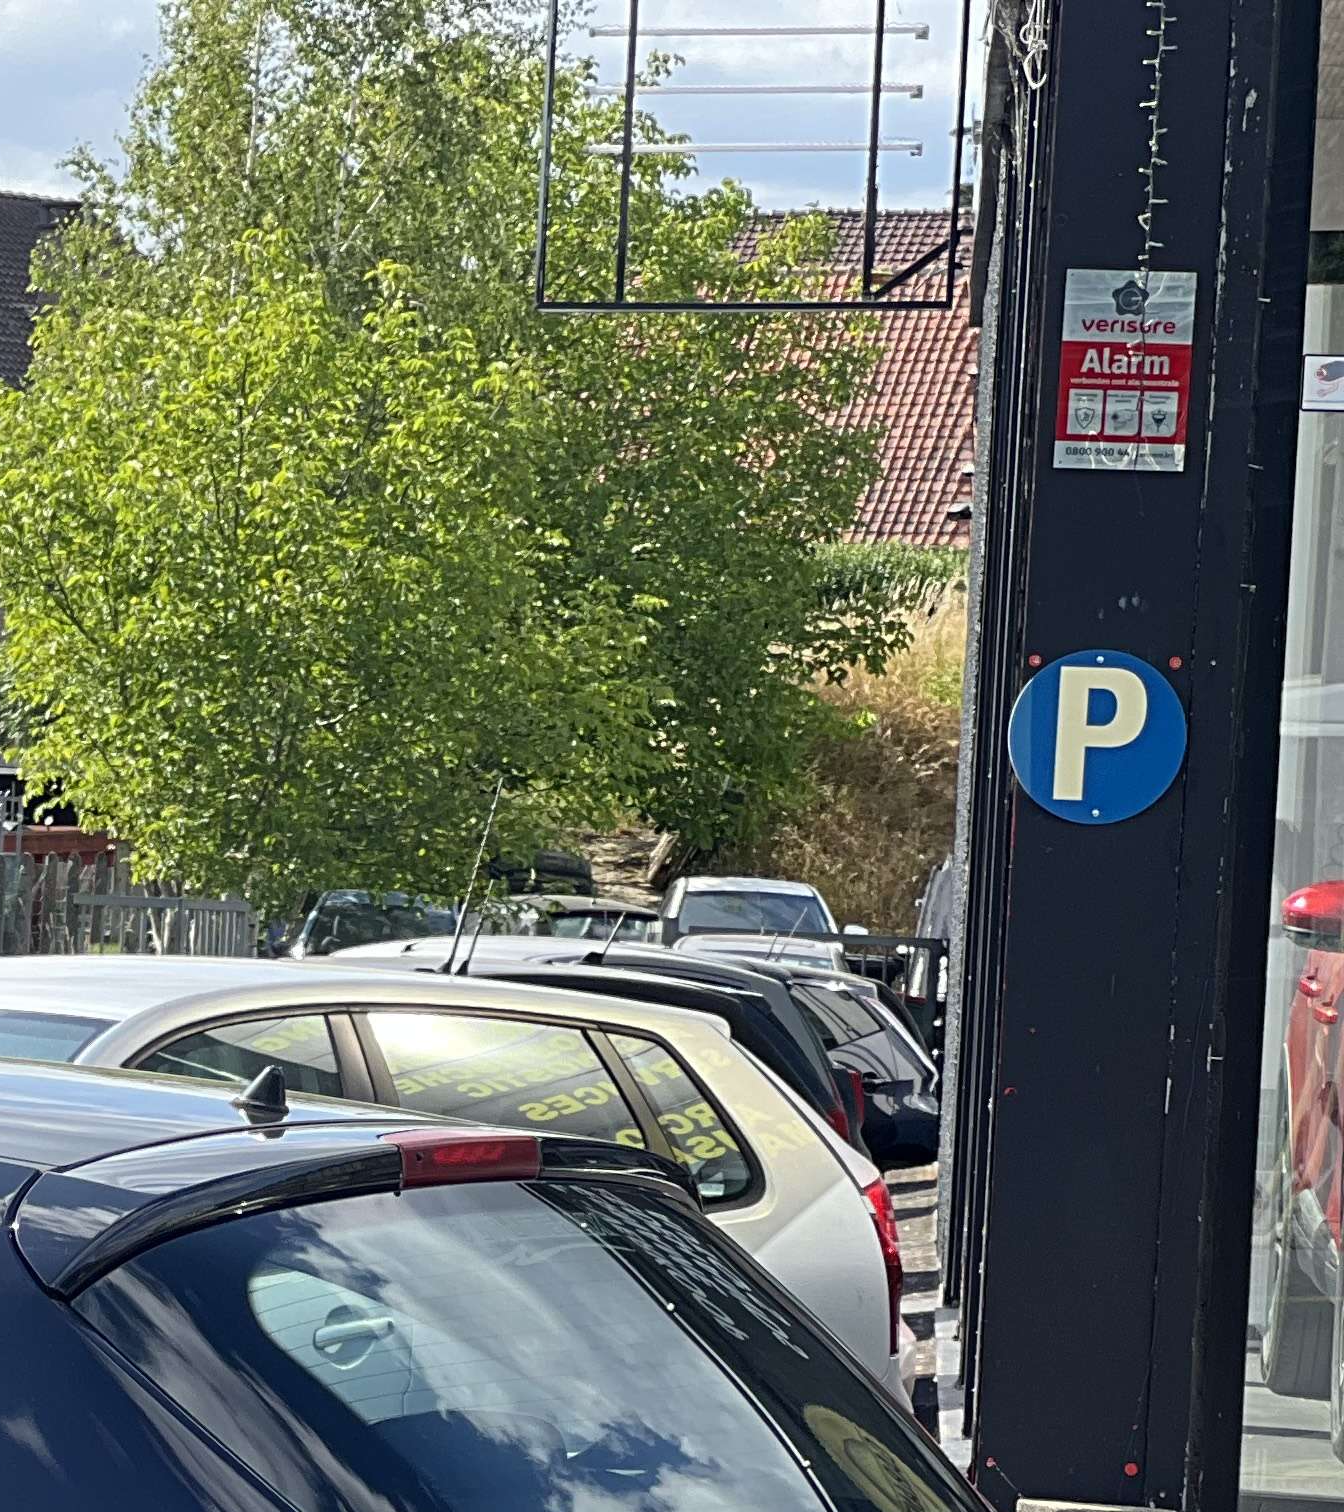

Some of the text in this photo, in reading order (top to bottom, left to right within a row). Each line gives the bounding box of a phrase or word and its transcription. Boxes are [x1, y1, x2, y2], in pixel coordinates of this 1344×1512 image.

[1081, 318, 1176, 334] verisure
[1080, 347, 1170, 375] Alarm
[1051, 666, 1149, 801] P
